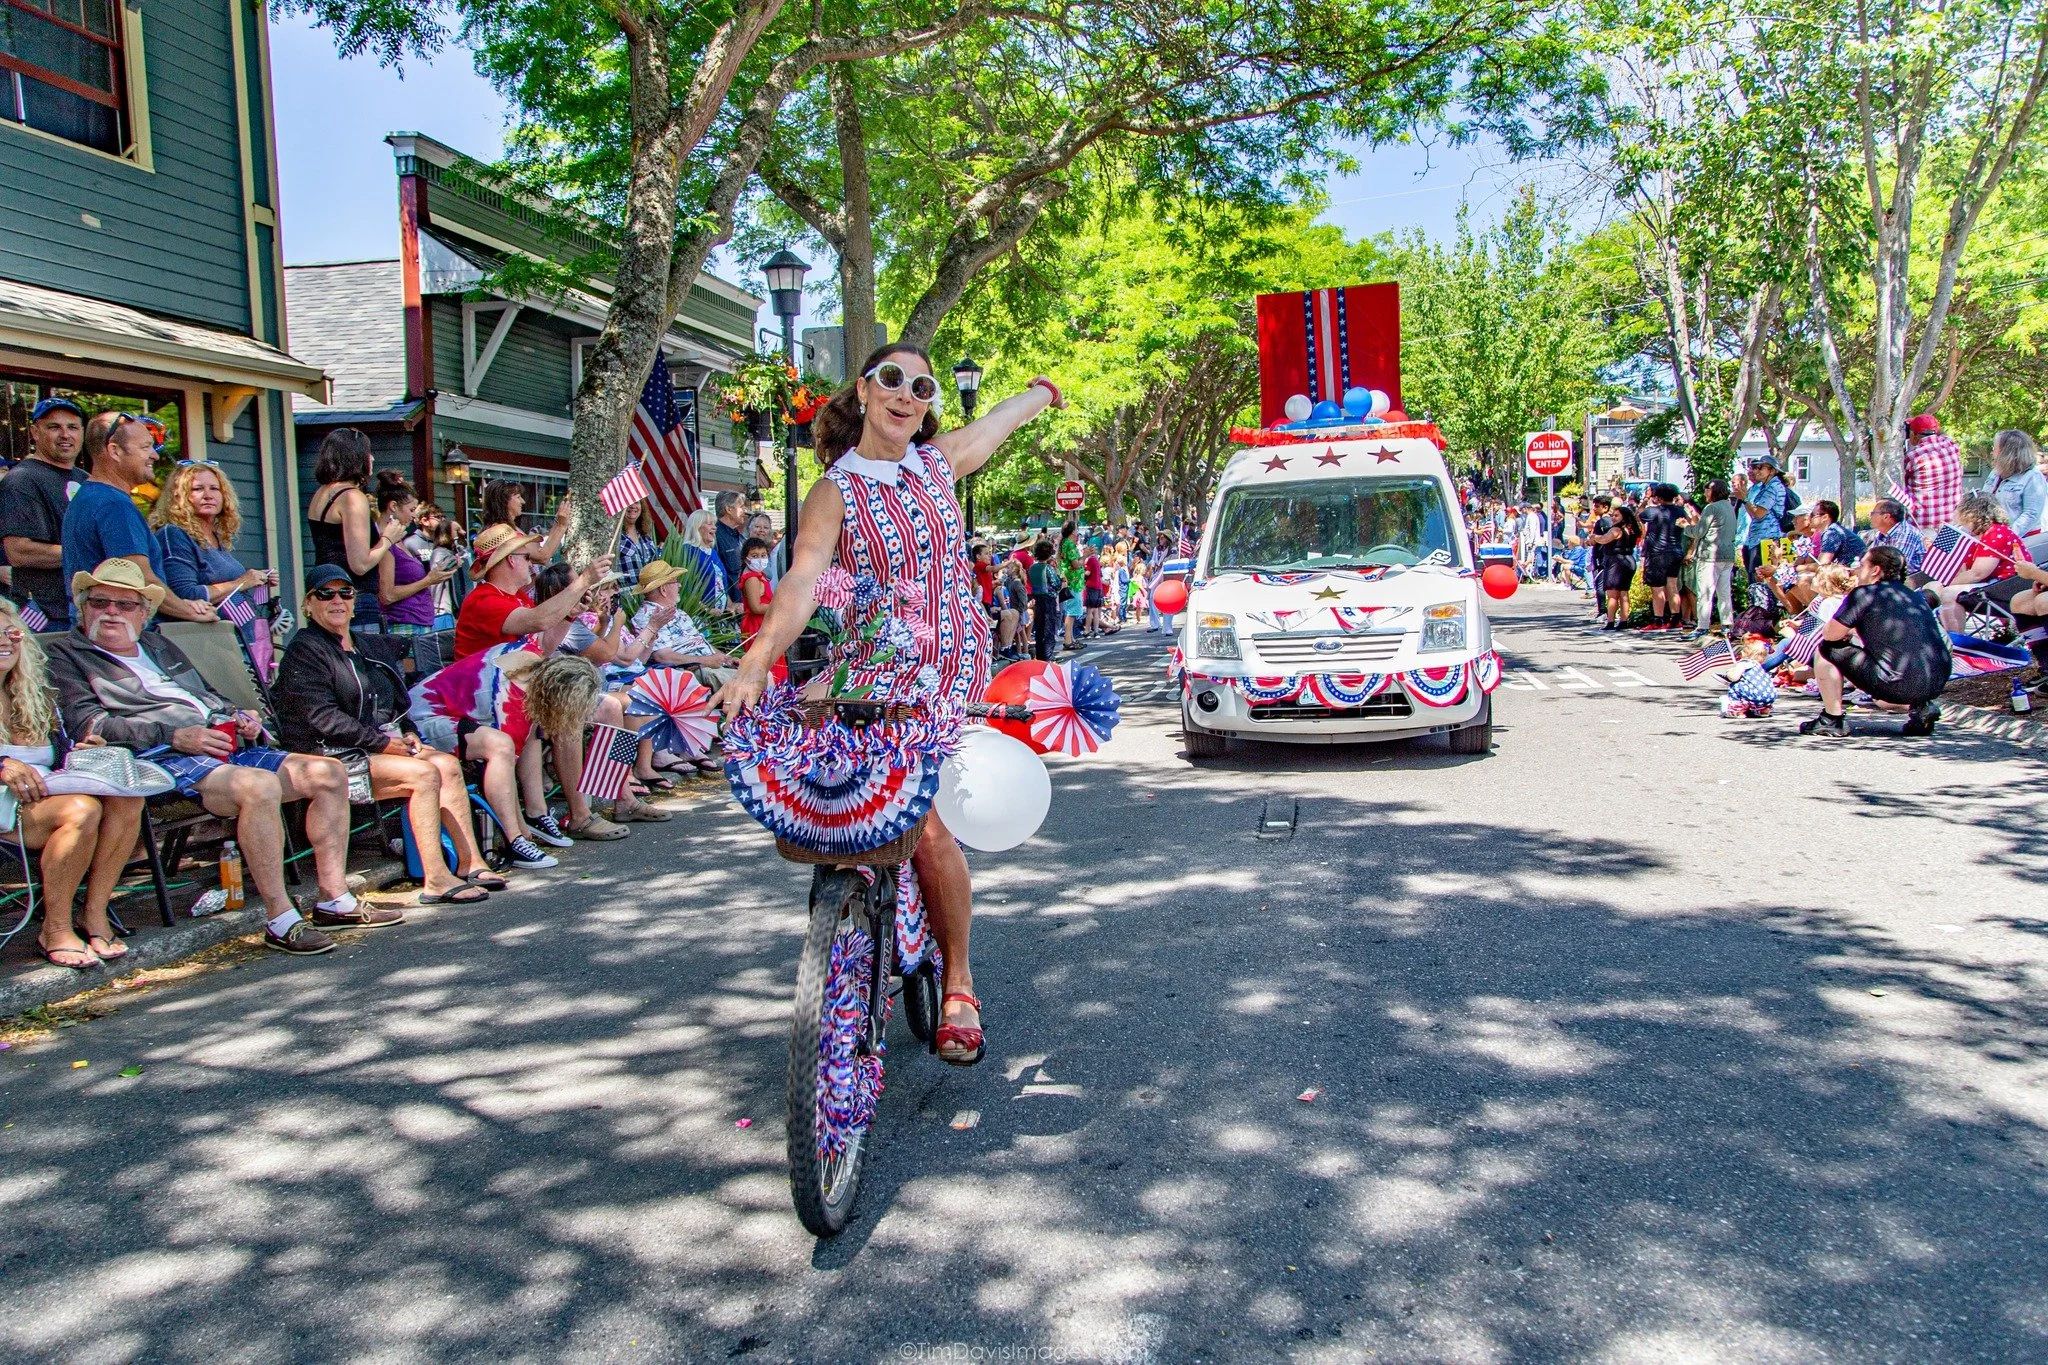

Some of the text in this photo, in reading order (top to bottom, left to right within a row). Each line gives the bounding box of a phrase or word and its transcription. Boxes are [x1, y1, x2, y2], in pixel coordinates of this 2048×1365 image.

[1532, 440, 1565, 449] DO NOT
[1535, 460, 1562, 469] ENTER
